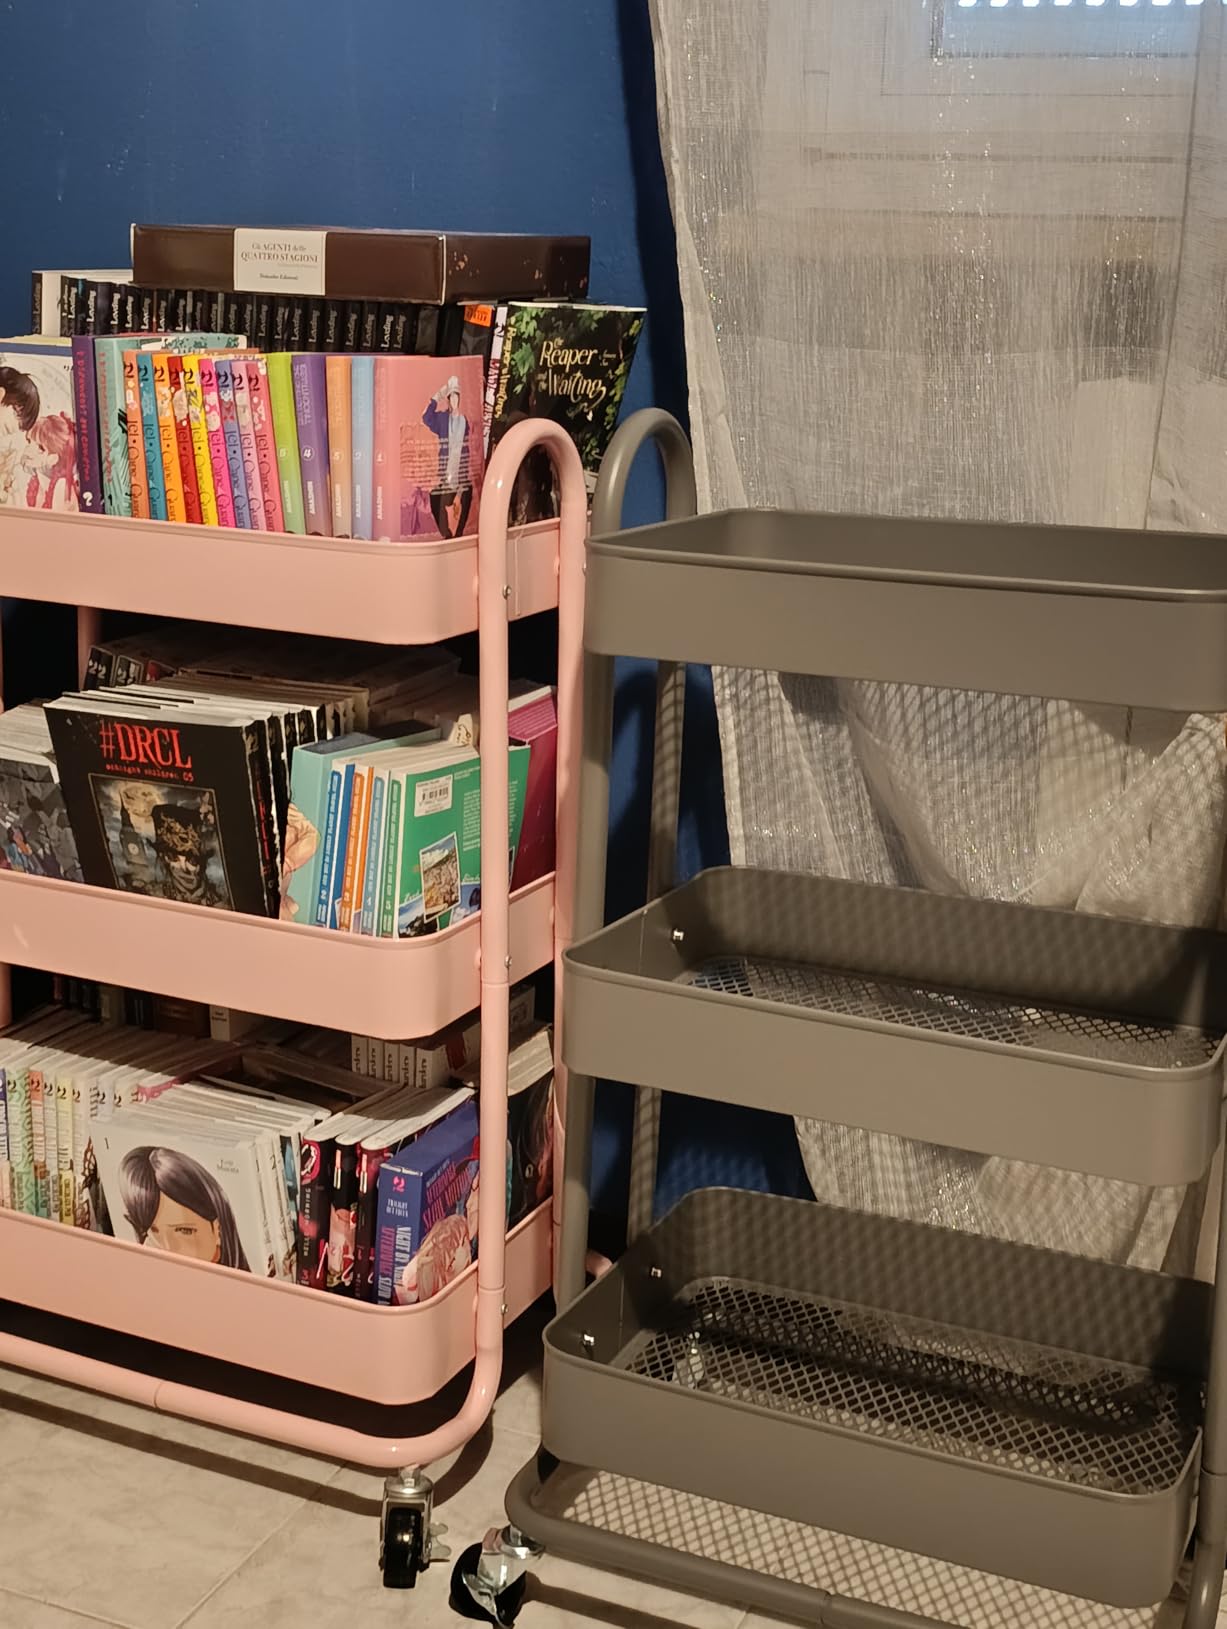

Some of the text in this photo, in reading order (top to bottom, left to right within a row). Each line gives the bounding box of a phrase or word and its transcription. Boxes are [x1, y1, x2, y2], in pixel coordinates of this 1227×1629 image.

[241, 252, 319, 263] QUATTRO STAGIONI
[263, 243, 291, 252] AGENTI
[539, 341, 598, 373] Reaper
[548, 368, 607, 404] Waiting
[82, 492, 93, 506] 2
[99, 719, 193, 769] #DRCL
[397, 1226, 411, 1249] NIGHT
